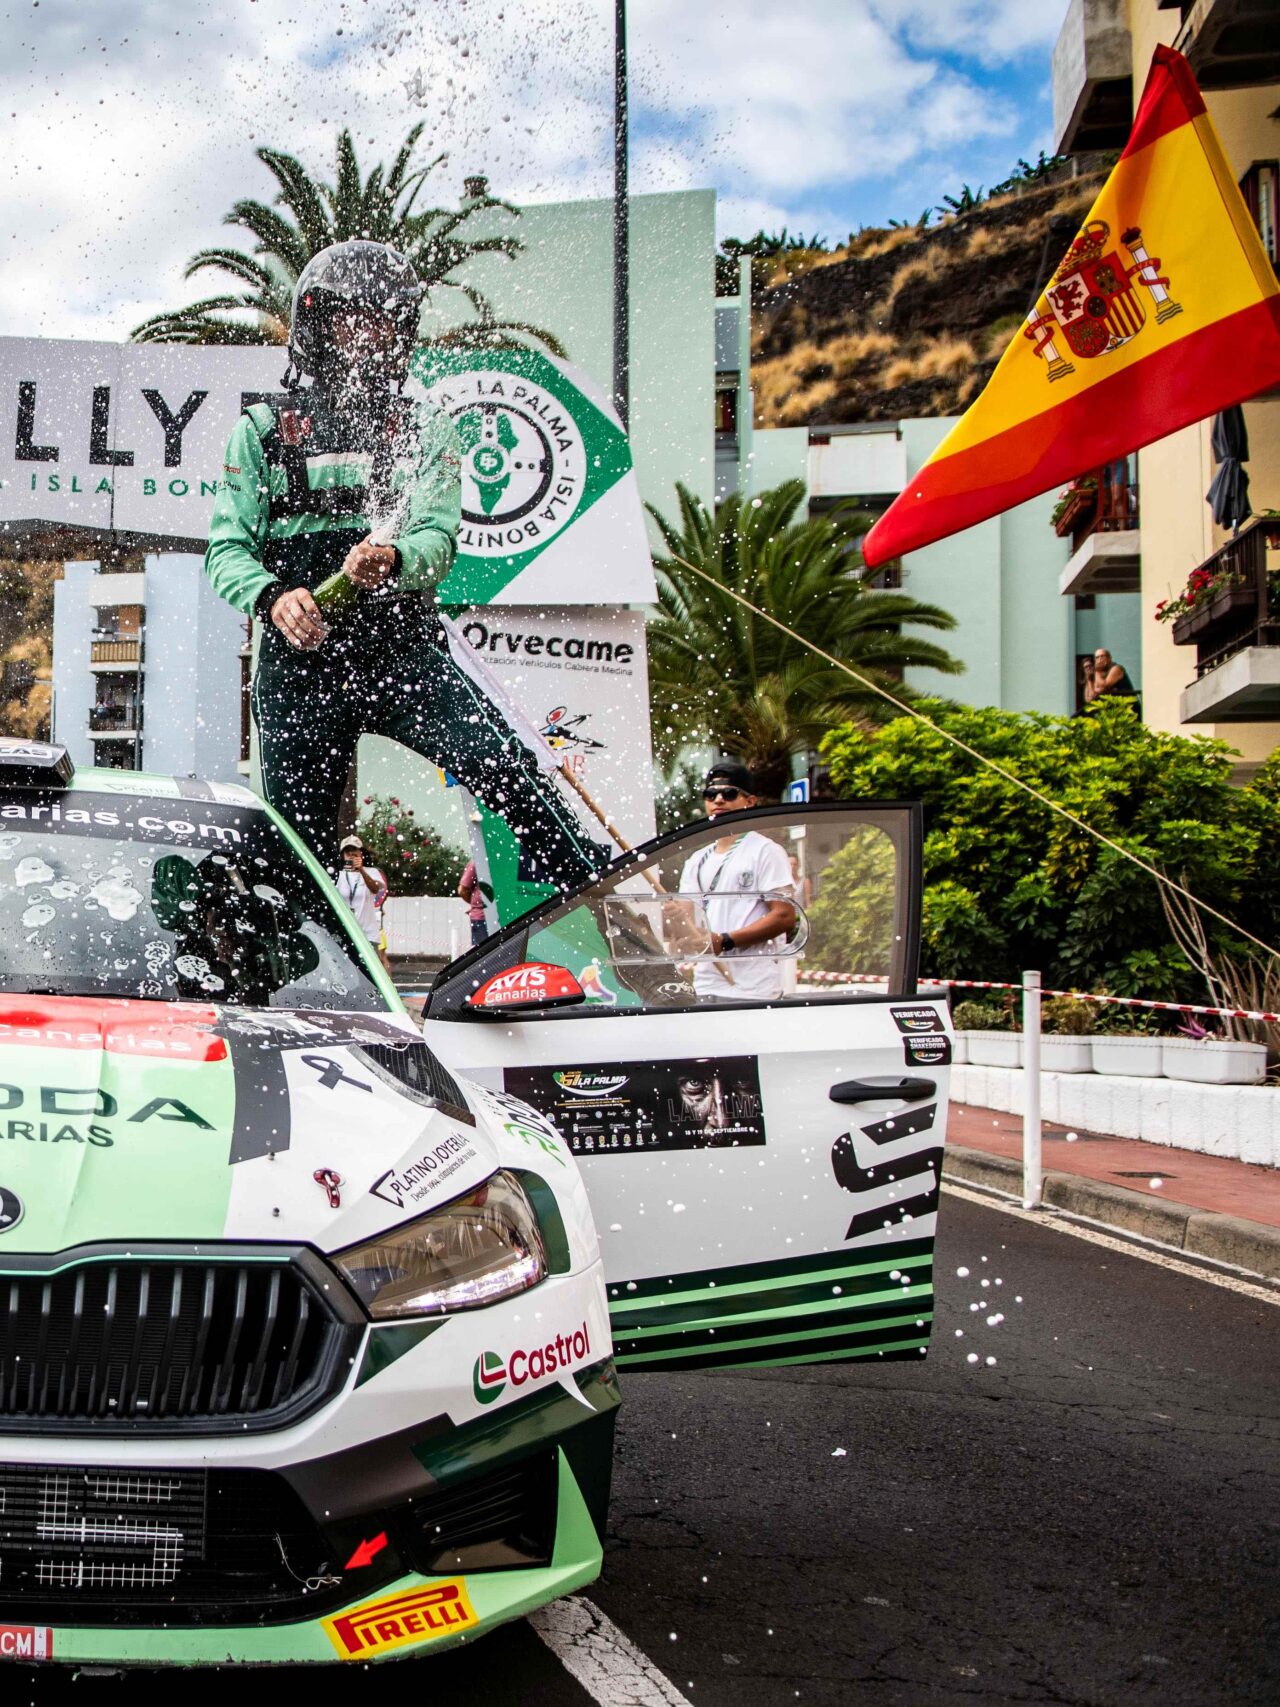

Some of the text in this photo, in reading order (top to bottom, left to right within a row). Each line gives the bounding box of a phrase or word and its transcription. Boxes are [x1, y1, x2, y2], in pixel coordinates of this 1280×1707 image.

[477, 380, 573, 452] LA PALMA
[31, 473, 115, 494] ISLA
[144, 479, 219, 497] BON
[539, 476, 576, 522] ISLA
[462, 621, 634, 664] Orvecame
[485, 966, 546, 994] AVIS
[485, 986, 547, 1004] Canarias
[893, 1010, 937, 1018] VERIFICADO
[592, 1075, 627, 1085] PALMA
[713, 1126, 748, 1134] SEPTIEMBRE
[391, 1156, 438, 1197] PLATINO
[509, 1320, 590, 1386] Castrol
[332, 1585, 469, 1654] PIRELLI
